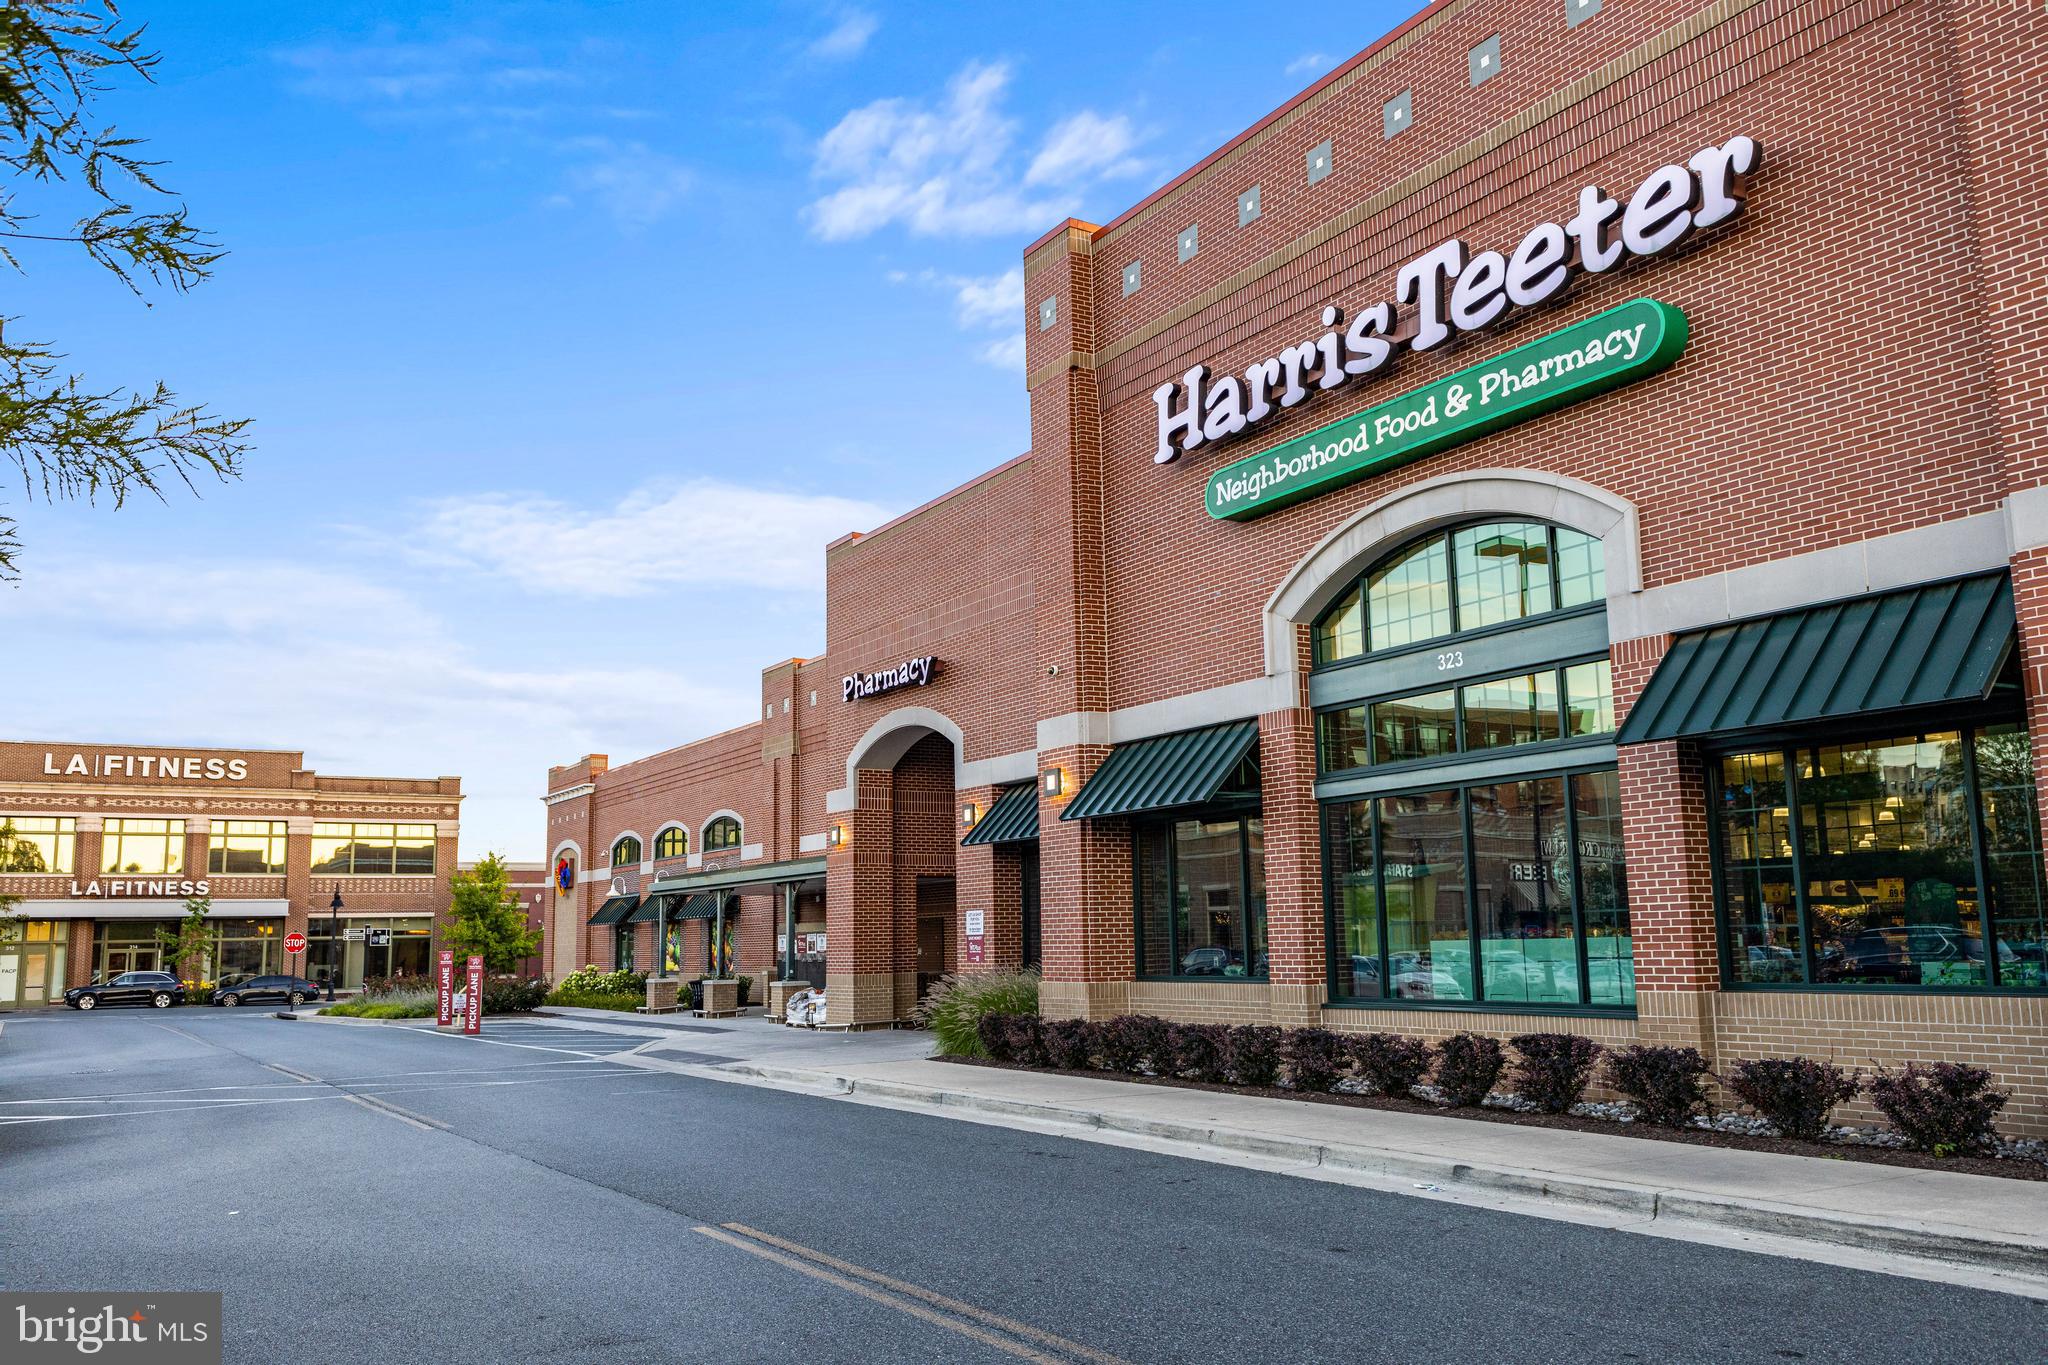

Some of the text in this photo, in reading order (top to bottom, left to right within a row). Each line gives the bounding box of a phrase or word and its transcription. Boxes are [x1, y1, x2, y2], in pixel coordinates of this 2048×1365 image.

[1153, 135, 1758, 465] Harris Teeter
[1215, 323, 1646, 506] Neighborhood Food & Pharmacy
[1437, 651, 1463, 670] 323
[842, 655, 933, 702] Pharmacy
[44, 753, 248, 780] LA FITNESS
[71, 880, 210, 896] LA FITNESS
[285, 939, 305, 947] STOP
[442, 967, 450, 989] LANE
[470, 972, 479, 996] LANE
[441, 990, 450, 1021] PICKUP
[469, 997, 478, 1030] PICKUP
